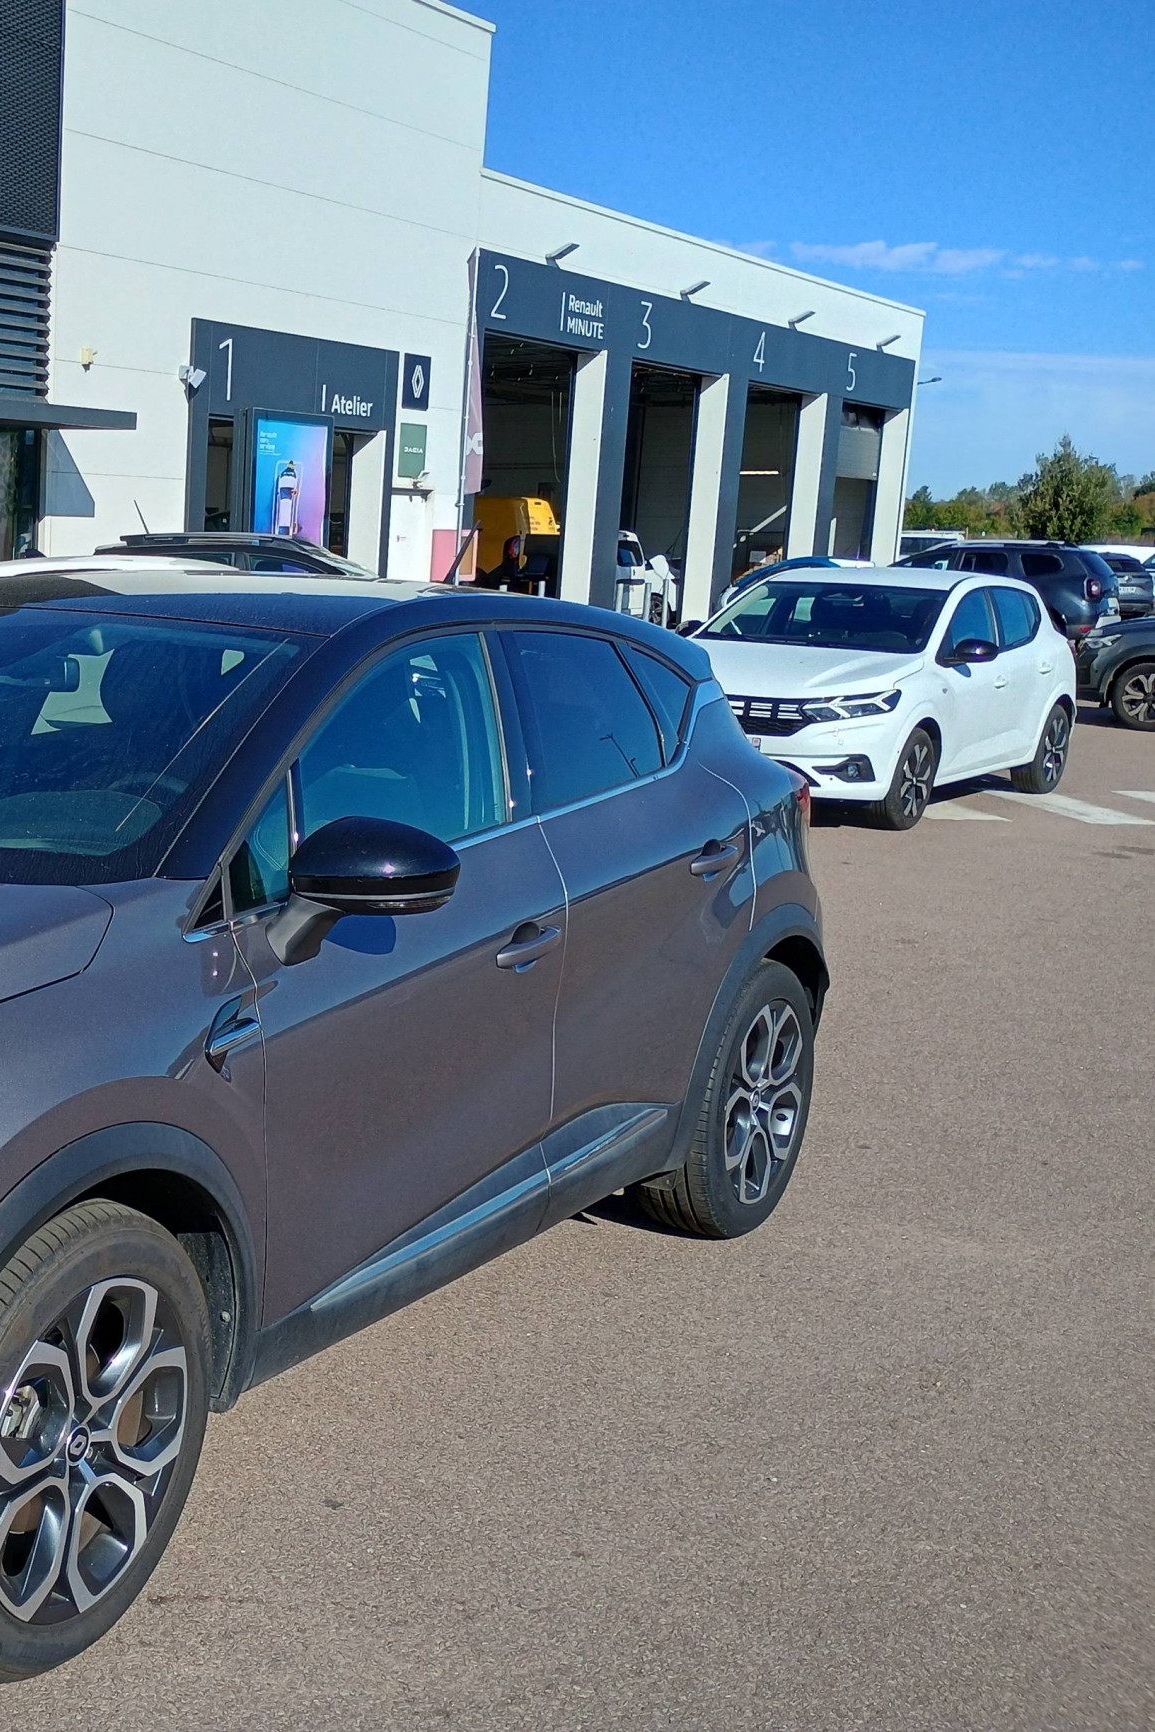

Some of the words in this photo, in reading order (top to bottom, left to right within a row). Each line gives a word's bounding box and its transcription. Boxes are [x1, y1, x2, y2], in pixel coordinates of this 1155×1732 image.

[490, 264, 509, 320] 2
[568, 294, 603, 318] Renault
[567, 316, 605, 340] MINUTE
[637, 301, 653, 349] 3
[219, 338, 233, 401] 1
[753, 331, 766, 373] 4
[846, 352, 858, 391] 5
[331, 394, 373, 417] Atelier
[404, 446, 424, 454] DACIA
